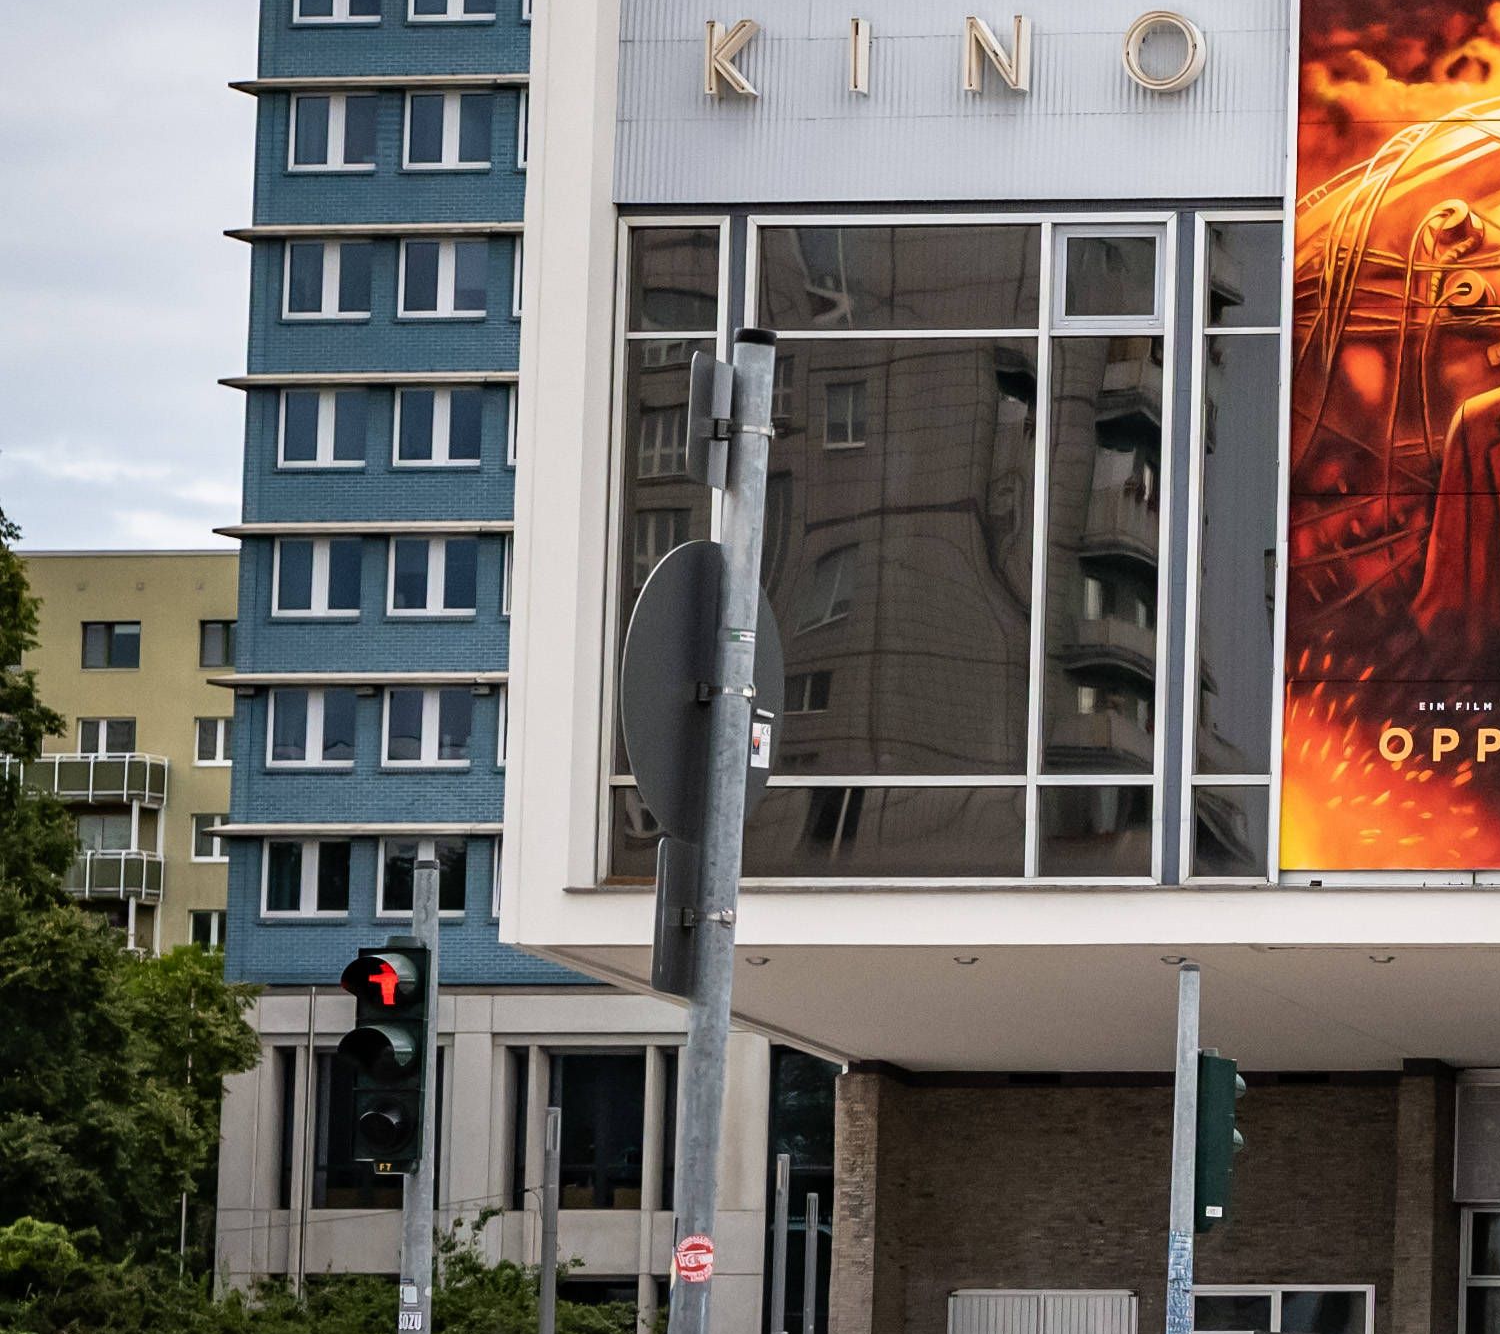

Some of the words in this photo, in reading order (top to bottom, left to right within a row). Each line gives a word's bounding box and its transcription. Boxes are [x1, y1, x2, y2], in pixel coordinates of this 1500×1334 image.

[702, 10, 1207, 98] KINO
[1419, 701, 1446, 711] EIN
[1455, 701, 1493, 711] FILM
